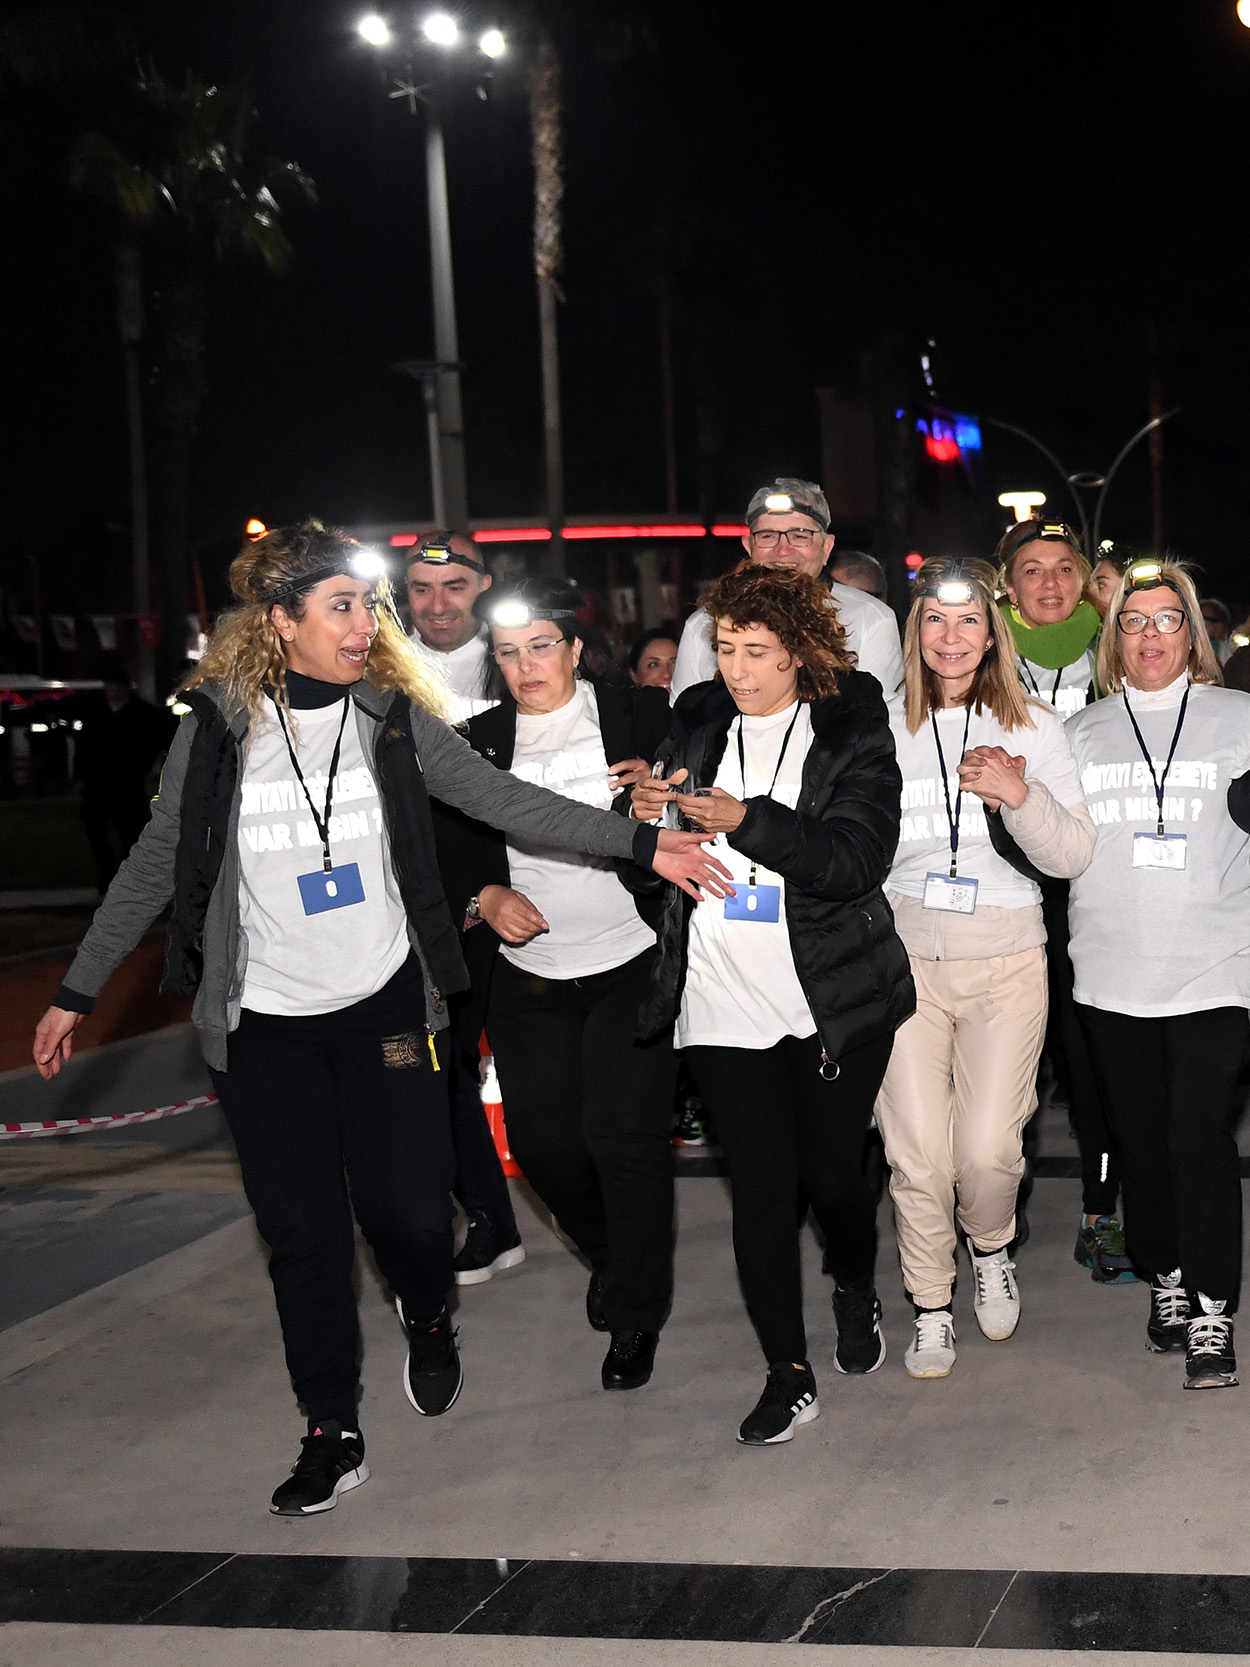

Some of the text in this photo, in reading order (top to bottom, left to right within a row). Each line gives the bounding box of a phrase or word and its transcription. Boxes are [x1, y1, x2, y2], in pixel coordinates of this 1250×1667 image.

[1087, 799, 1122, 826] VAR
[1190, 798, 1203, 822] ?
[242, 823, 294, 853] VAR
[899, 815, 932, 842] AR
